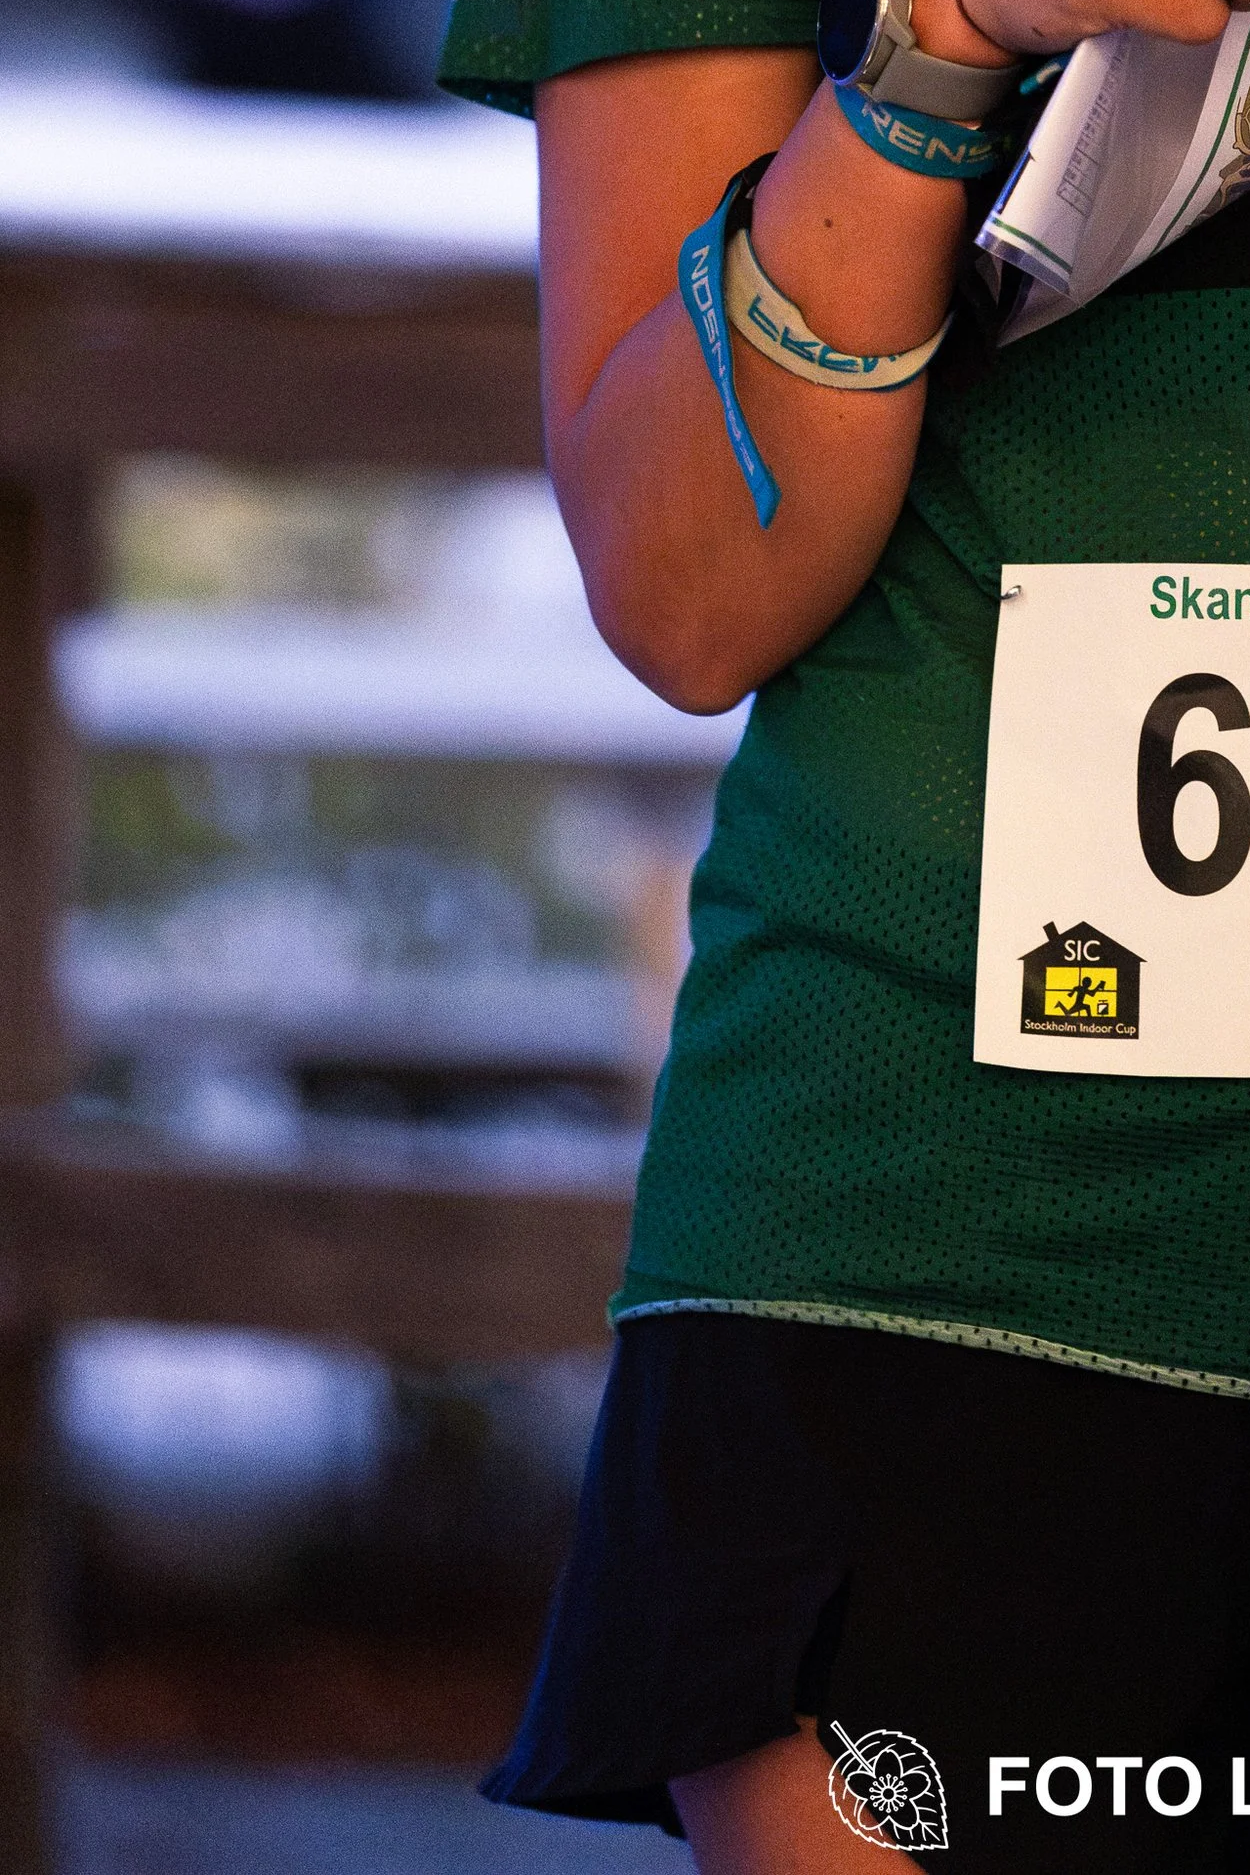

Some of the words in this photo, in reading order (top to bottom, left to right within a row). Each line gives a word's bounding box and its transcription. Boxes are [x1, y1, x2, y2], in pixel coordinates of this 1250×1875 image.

[1063, 939, 1101, 962] SIC
[1024, 1019, 1077, 1033] Stockholm
[1079, 1023, 1113, 1034] Indoor
[1115, 1023, 1137, 1036] Cup
